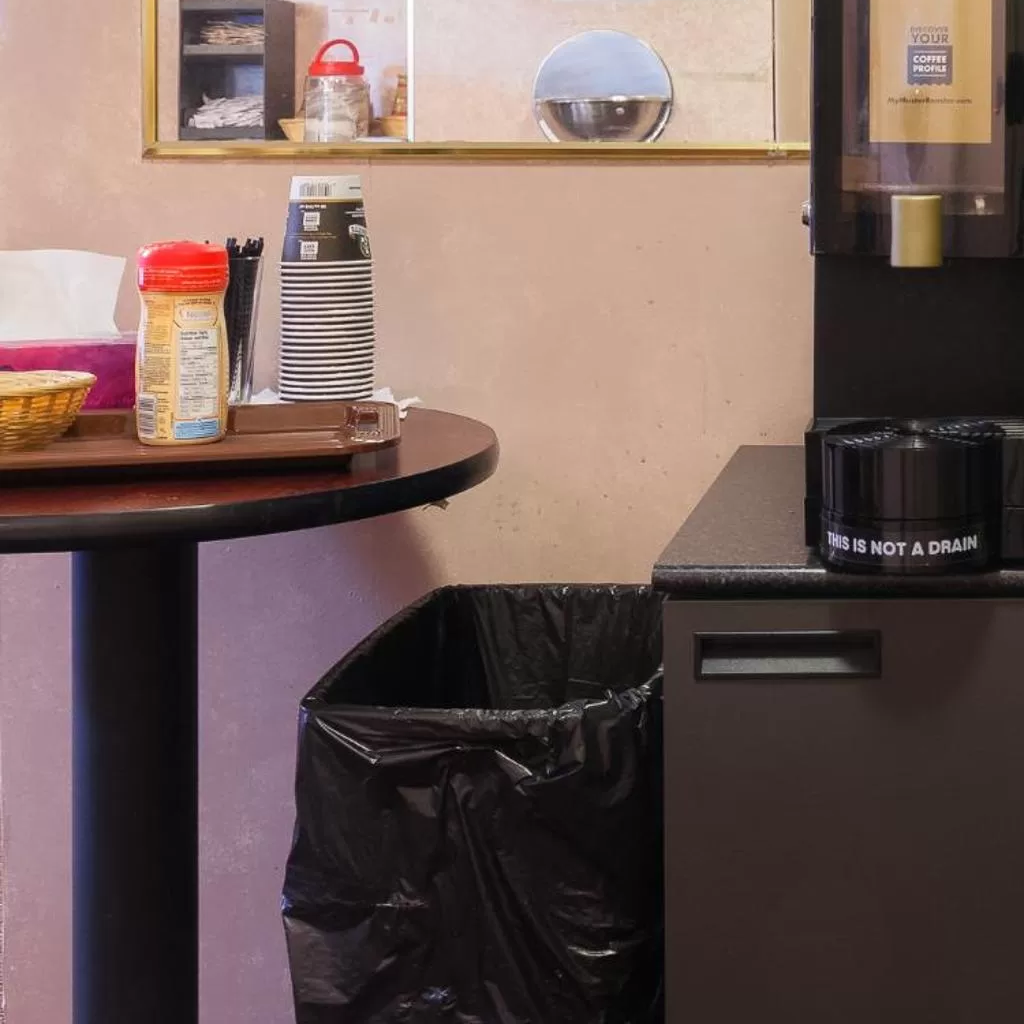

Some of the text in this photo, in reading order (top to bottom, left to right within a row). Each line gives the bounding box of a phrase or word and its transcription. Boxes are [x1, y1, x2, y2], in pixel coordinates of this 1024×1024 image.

[912, 33, 949, 44] YOUR
[913, 55, 947, 63] COFFEE
[912, 64, 947, 73] PROFILE
[827, 531, 978, 556] THIS IS NOT A DRAIN
